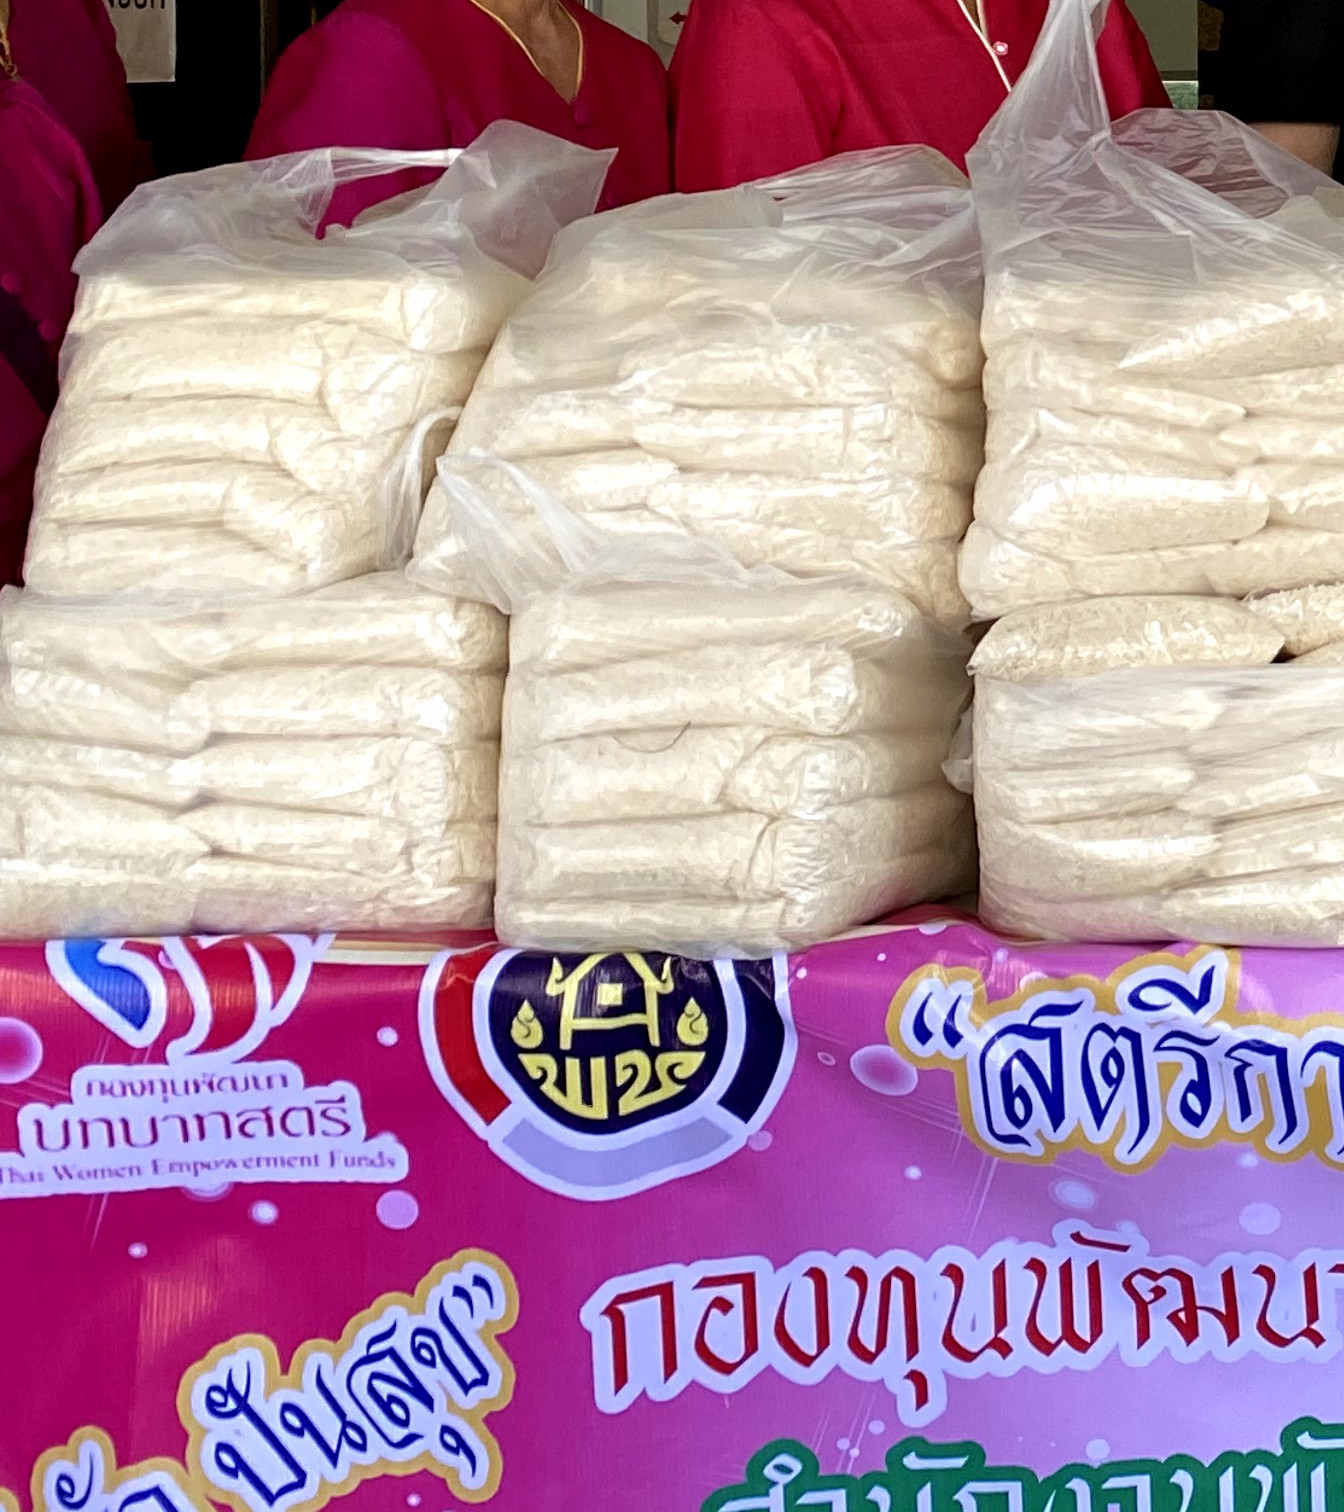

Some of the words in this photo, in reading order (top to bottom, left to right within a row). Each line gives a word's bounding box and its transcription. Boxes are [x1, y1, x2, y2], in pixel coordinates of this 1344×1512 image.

[33, 1093, 352, 1153] บทบาทสตรี
[53, 1162, 142, 1183] Women
[151, 1152, 320, 1179] Empowerment
[328, 1148, 397, 1171] Funds
